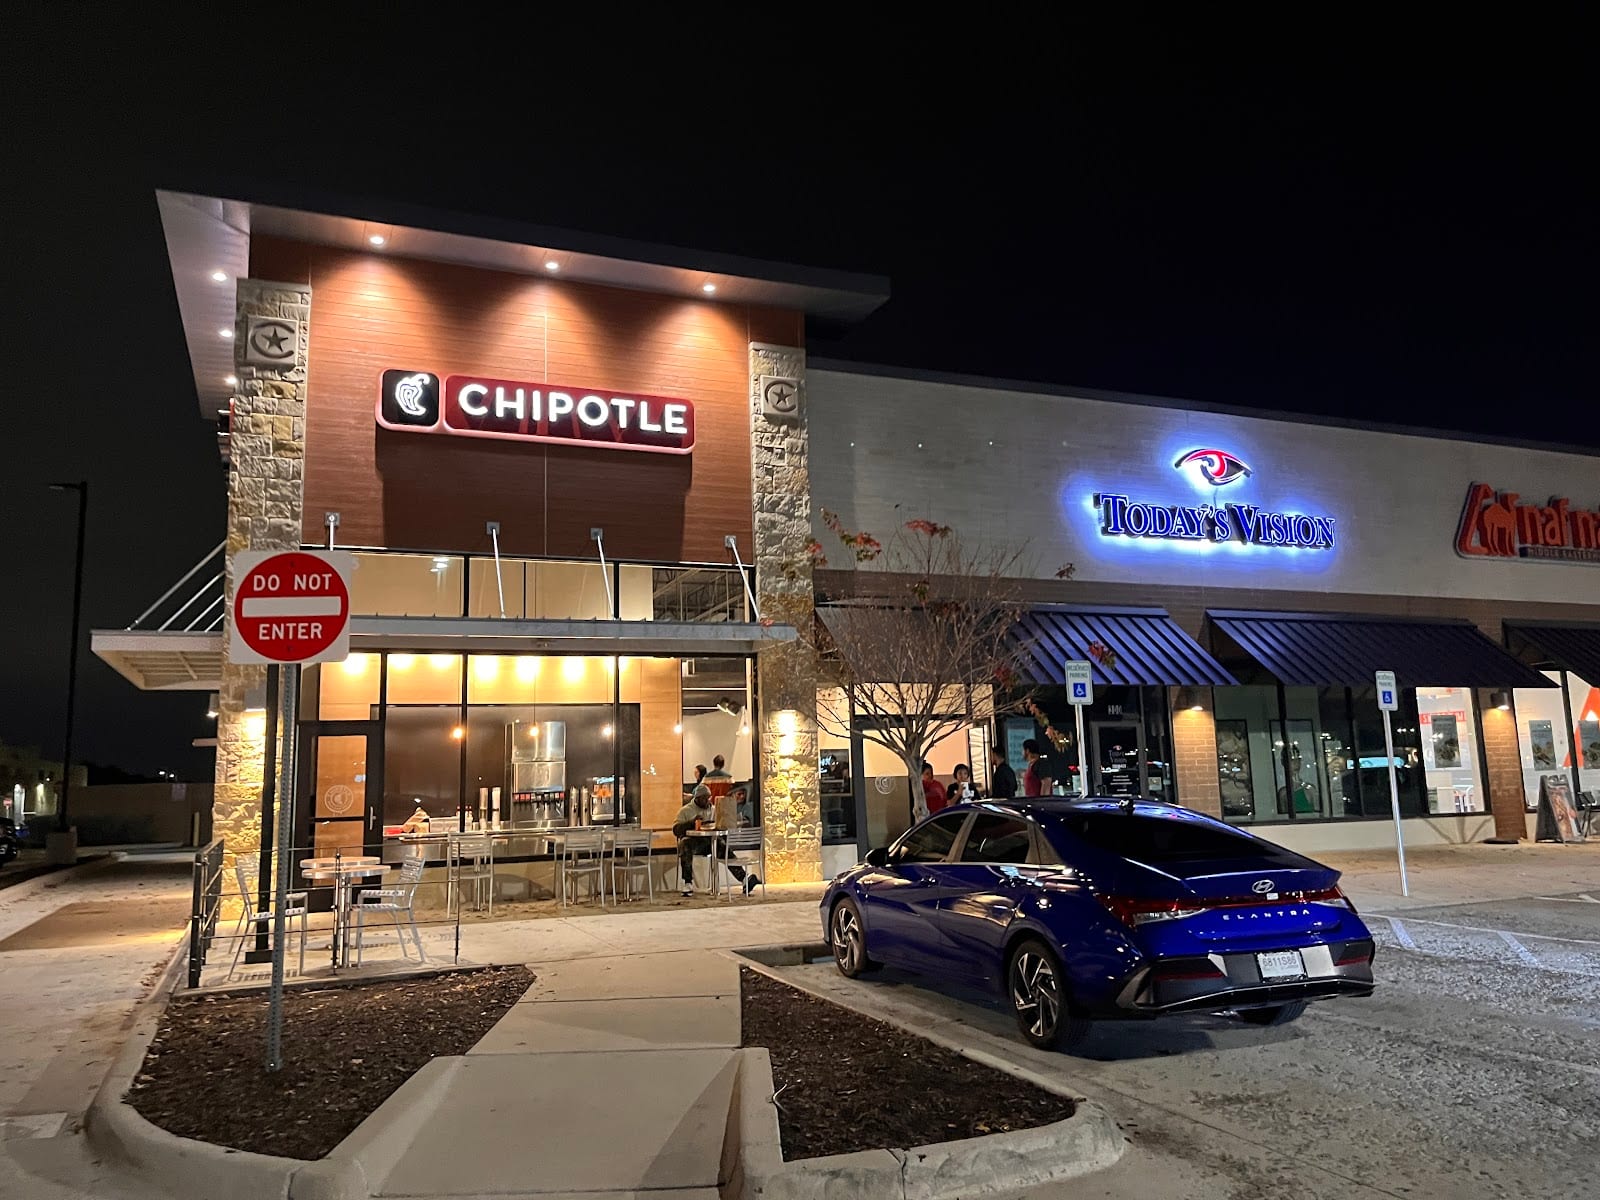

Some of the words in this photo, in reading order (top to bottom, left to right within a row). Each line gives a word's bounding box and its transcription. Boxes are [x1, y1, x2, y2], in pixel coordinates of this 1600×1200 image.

[457, 382, 689, 435] CHIPOTLE
[1100, 493, 1231, 541] TODAY'S
[1232, 504, 1336, 547] VISION
[253, 574, 280, 592] DO
[293, 573, 332, 591] NOT
[258, 622, 322, 640] ENTER
[1222, 909, 1310, 920] ELANTRA
